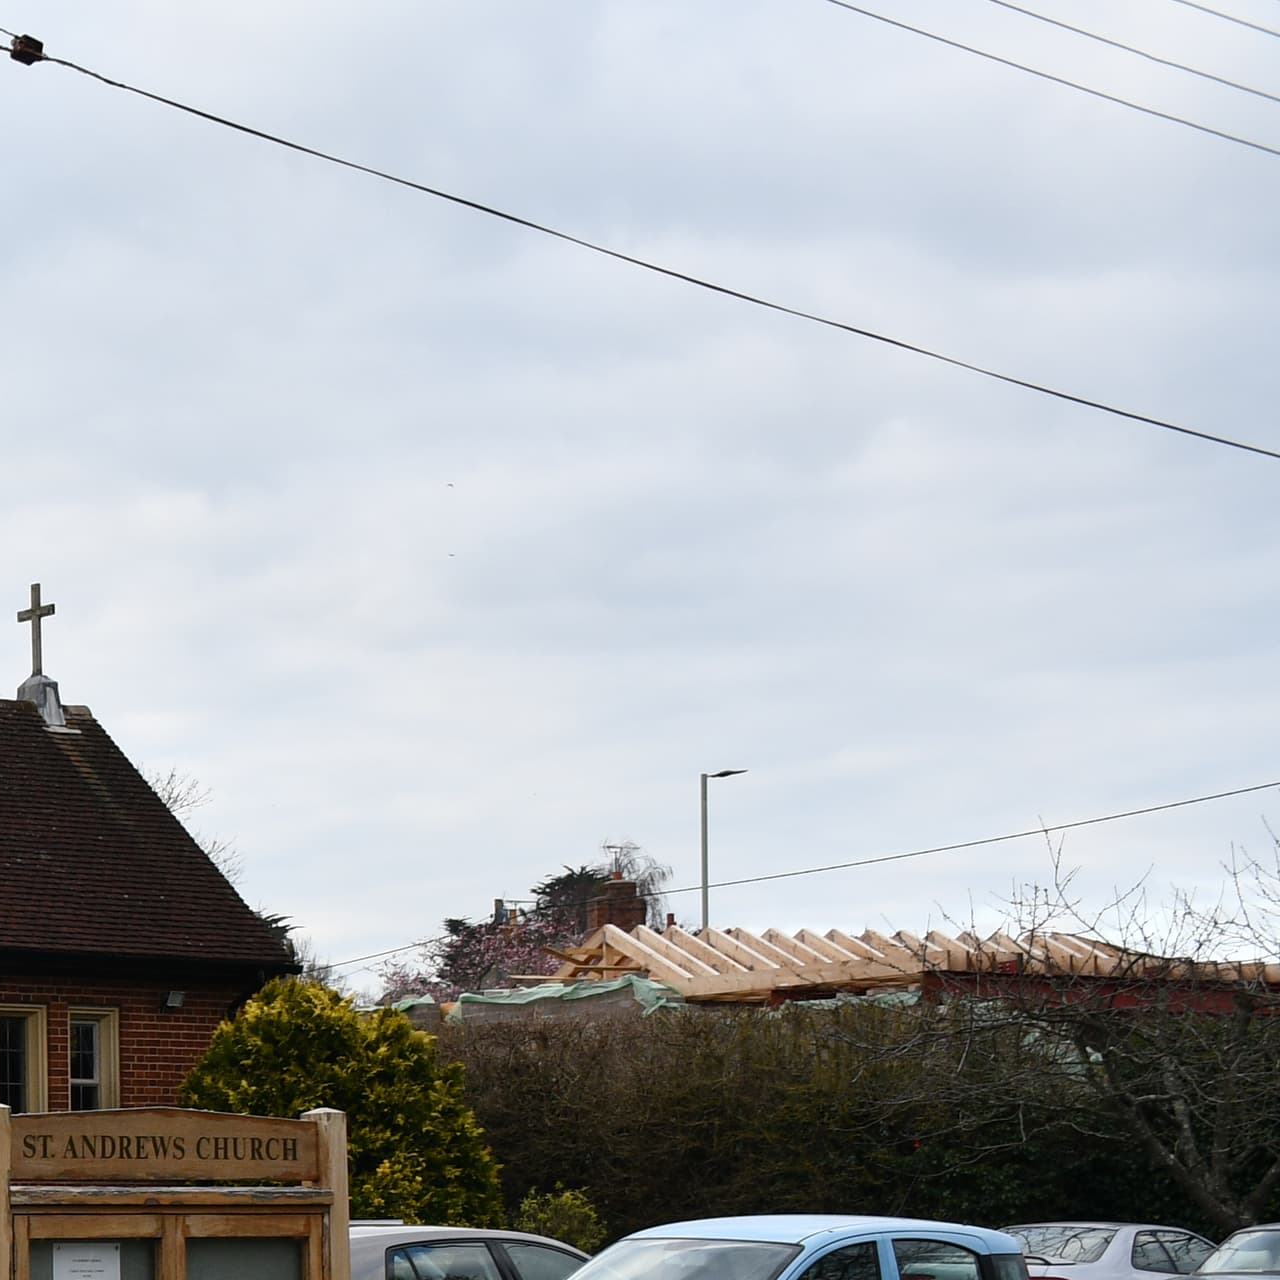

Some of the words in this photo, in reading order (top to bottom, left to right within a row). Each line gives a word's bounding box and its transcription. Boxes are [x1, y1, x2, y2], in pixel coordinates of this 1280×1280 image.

[22, 1134, 56, 1158] ST.
[63, 1134, 186, 1160] ANDREWS
[195, 1135, 298, 1161] CHURCH
